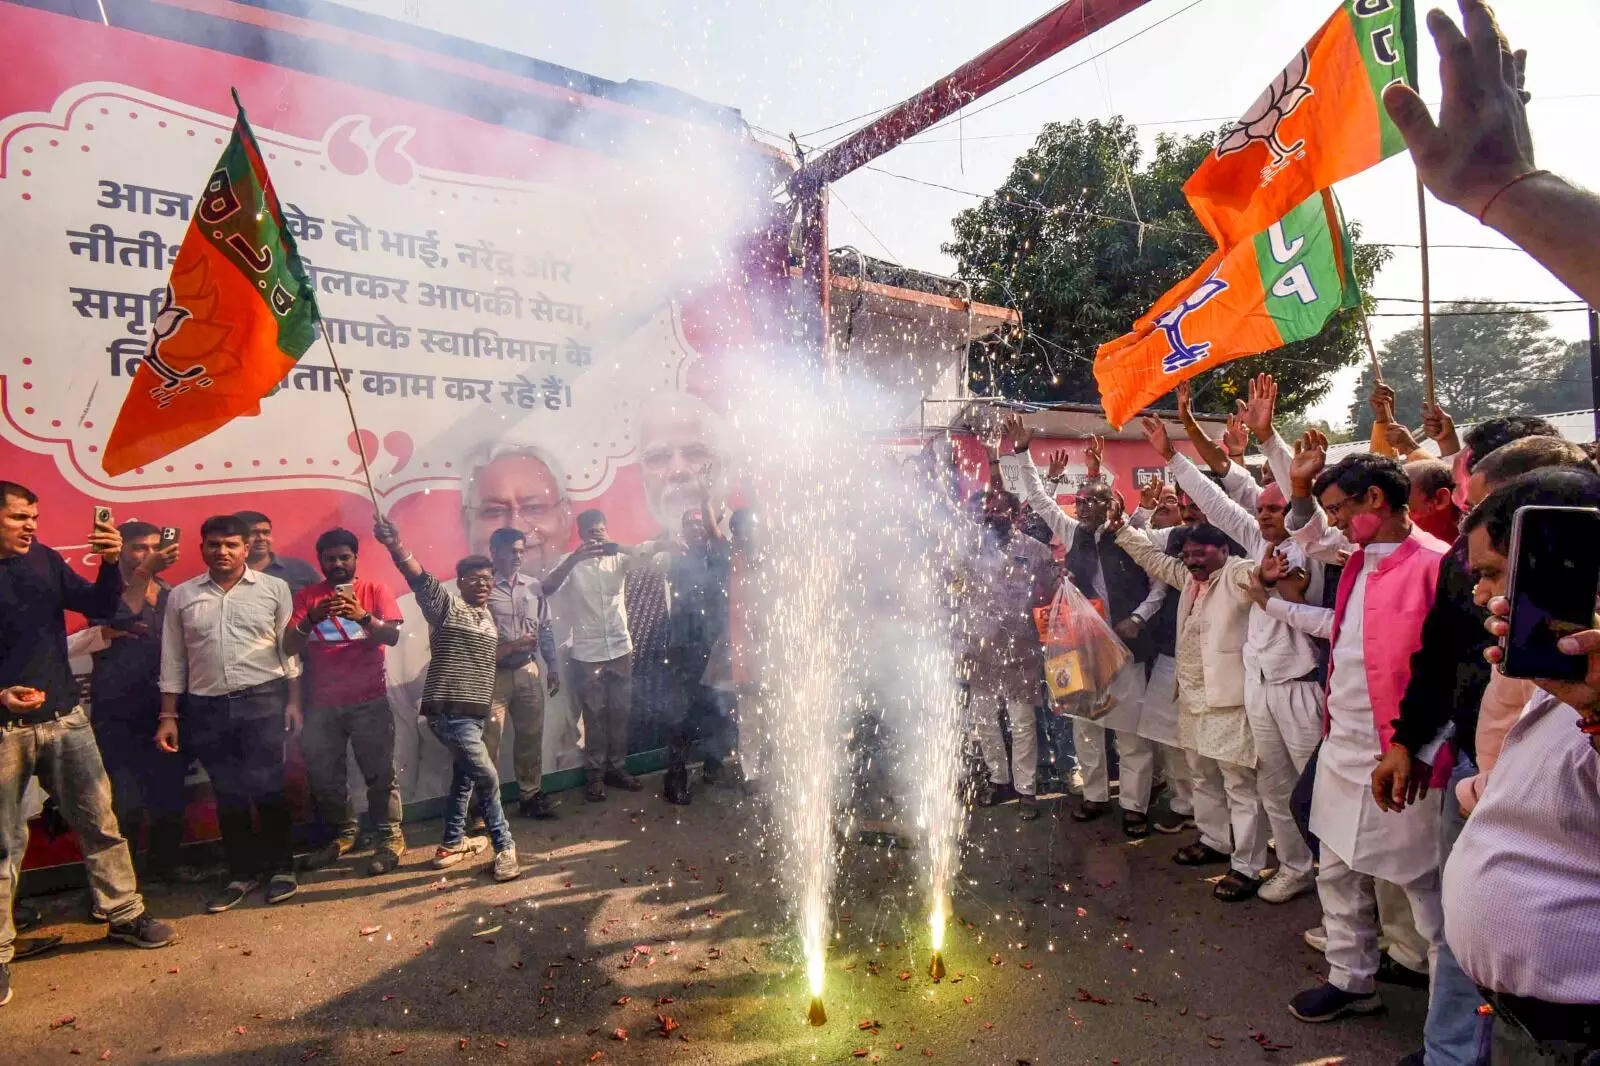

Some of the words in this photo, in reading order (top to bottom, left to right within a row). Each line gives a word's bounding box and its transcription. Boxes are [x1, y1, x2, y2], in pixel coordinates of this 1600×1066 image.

[97, 180, 194, 221] आज
[282, 202, 325, 241] के
[331, 214, 371, 252] दो
[377, 229, 448, 268] भाई,
[418, 281, 524, 319] आपकी
[528, 290, 592, 331] सेवा,
[417, 327, 559, 364] स्वाभिमान
[564, 336, 592, 367] के
[359, 369, 437, 400] काम
[442, 376, 494, 403] कर
[498, 374, 536, 409] रहे
